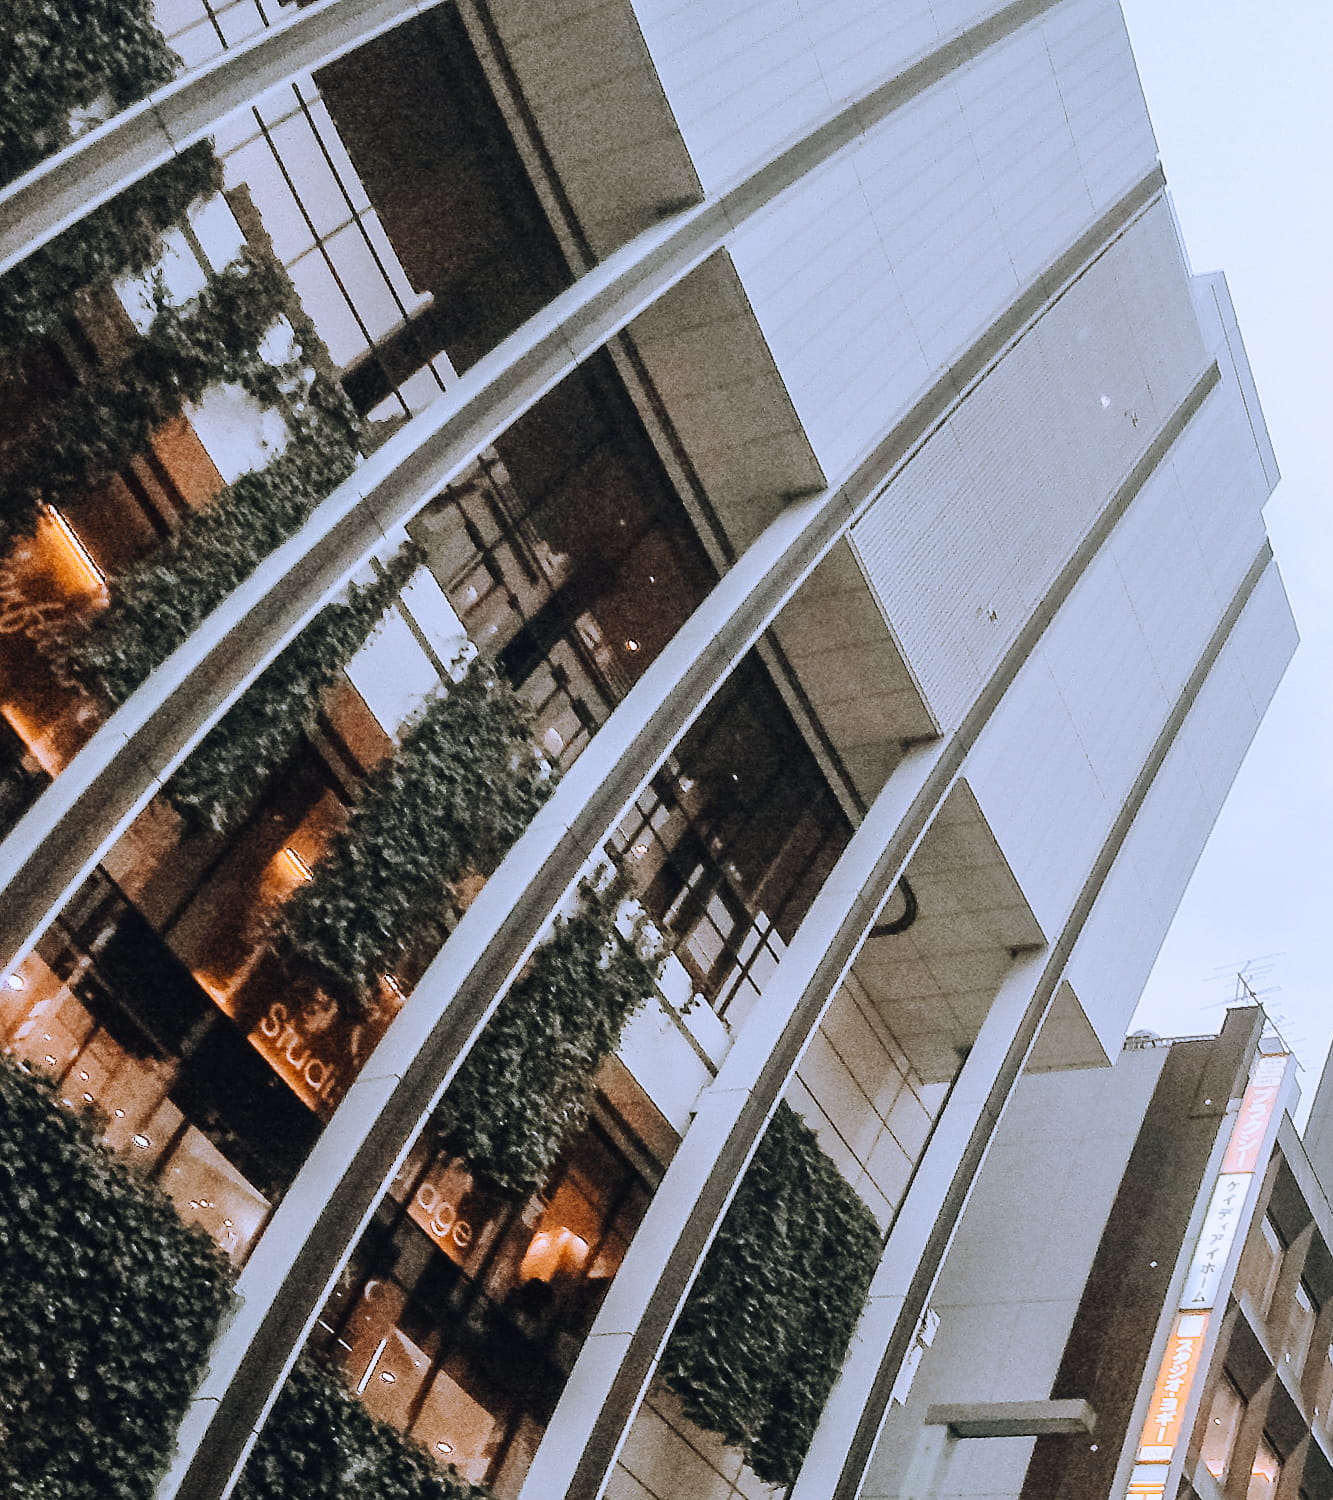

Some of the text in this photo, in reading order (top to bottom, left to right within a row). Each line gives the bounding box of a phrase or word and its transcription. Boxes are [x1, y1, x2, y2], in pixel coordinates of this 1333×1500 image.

[1191, 1181, 1240, 1303] ケイディアイホーム
[1154, 1339, 1194, 1443] スタジオ・ヨギー
